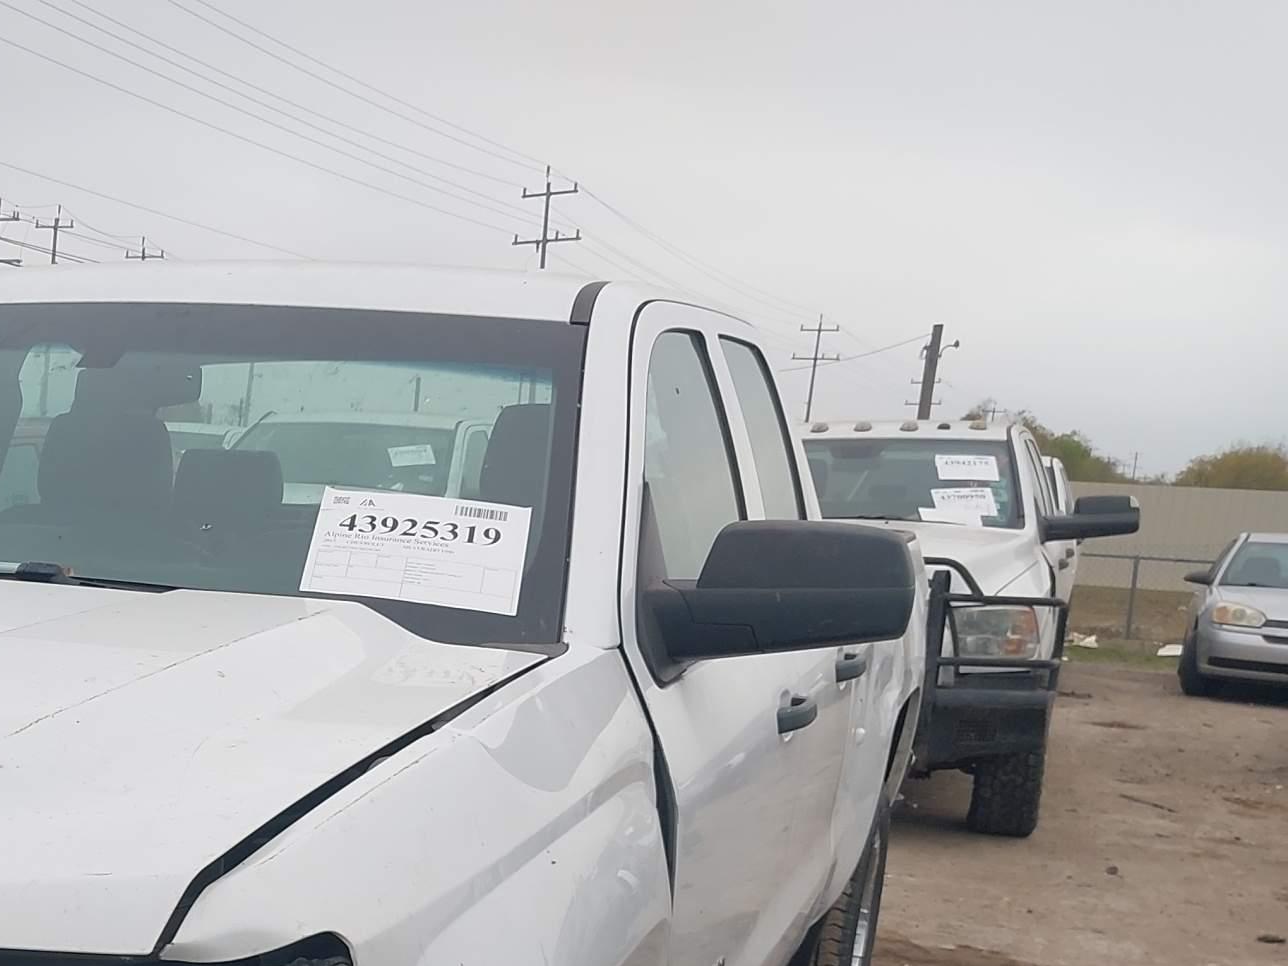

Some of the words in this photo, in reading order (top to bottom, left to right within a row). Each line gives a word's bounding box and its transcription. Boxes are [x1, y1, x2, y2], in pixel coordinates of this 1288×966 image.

[324, 530, 352, 539] Alpine
[372, 535, 412, 544] Insurance
[414, 539, 449, 548] Services
[338, 513, 502, 546] 43925319
